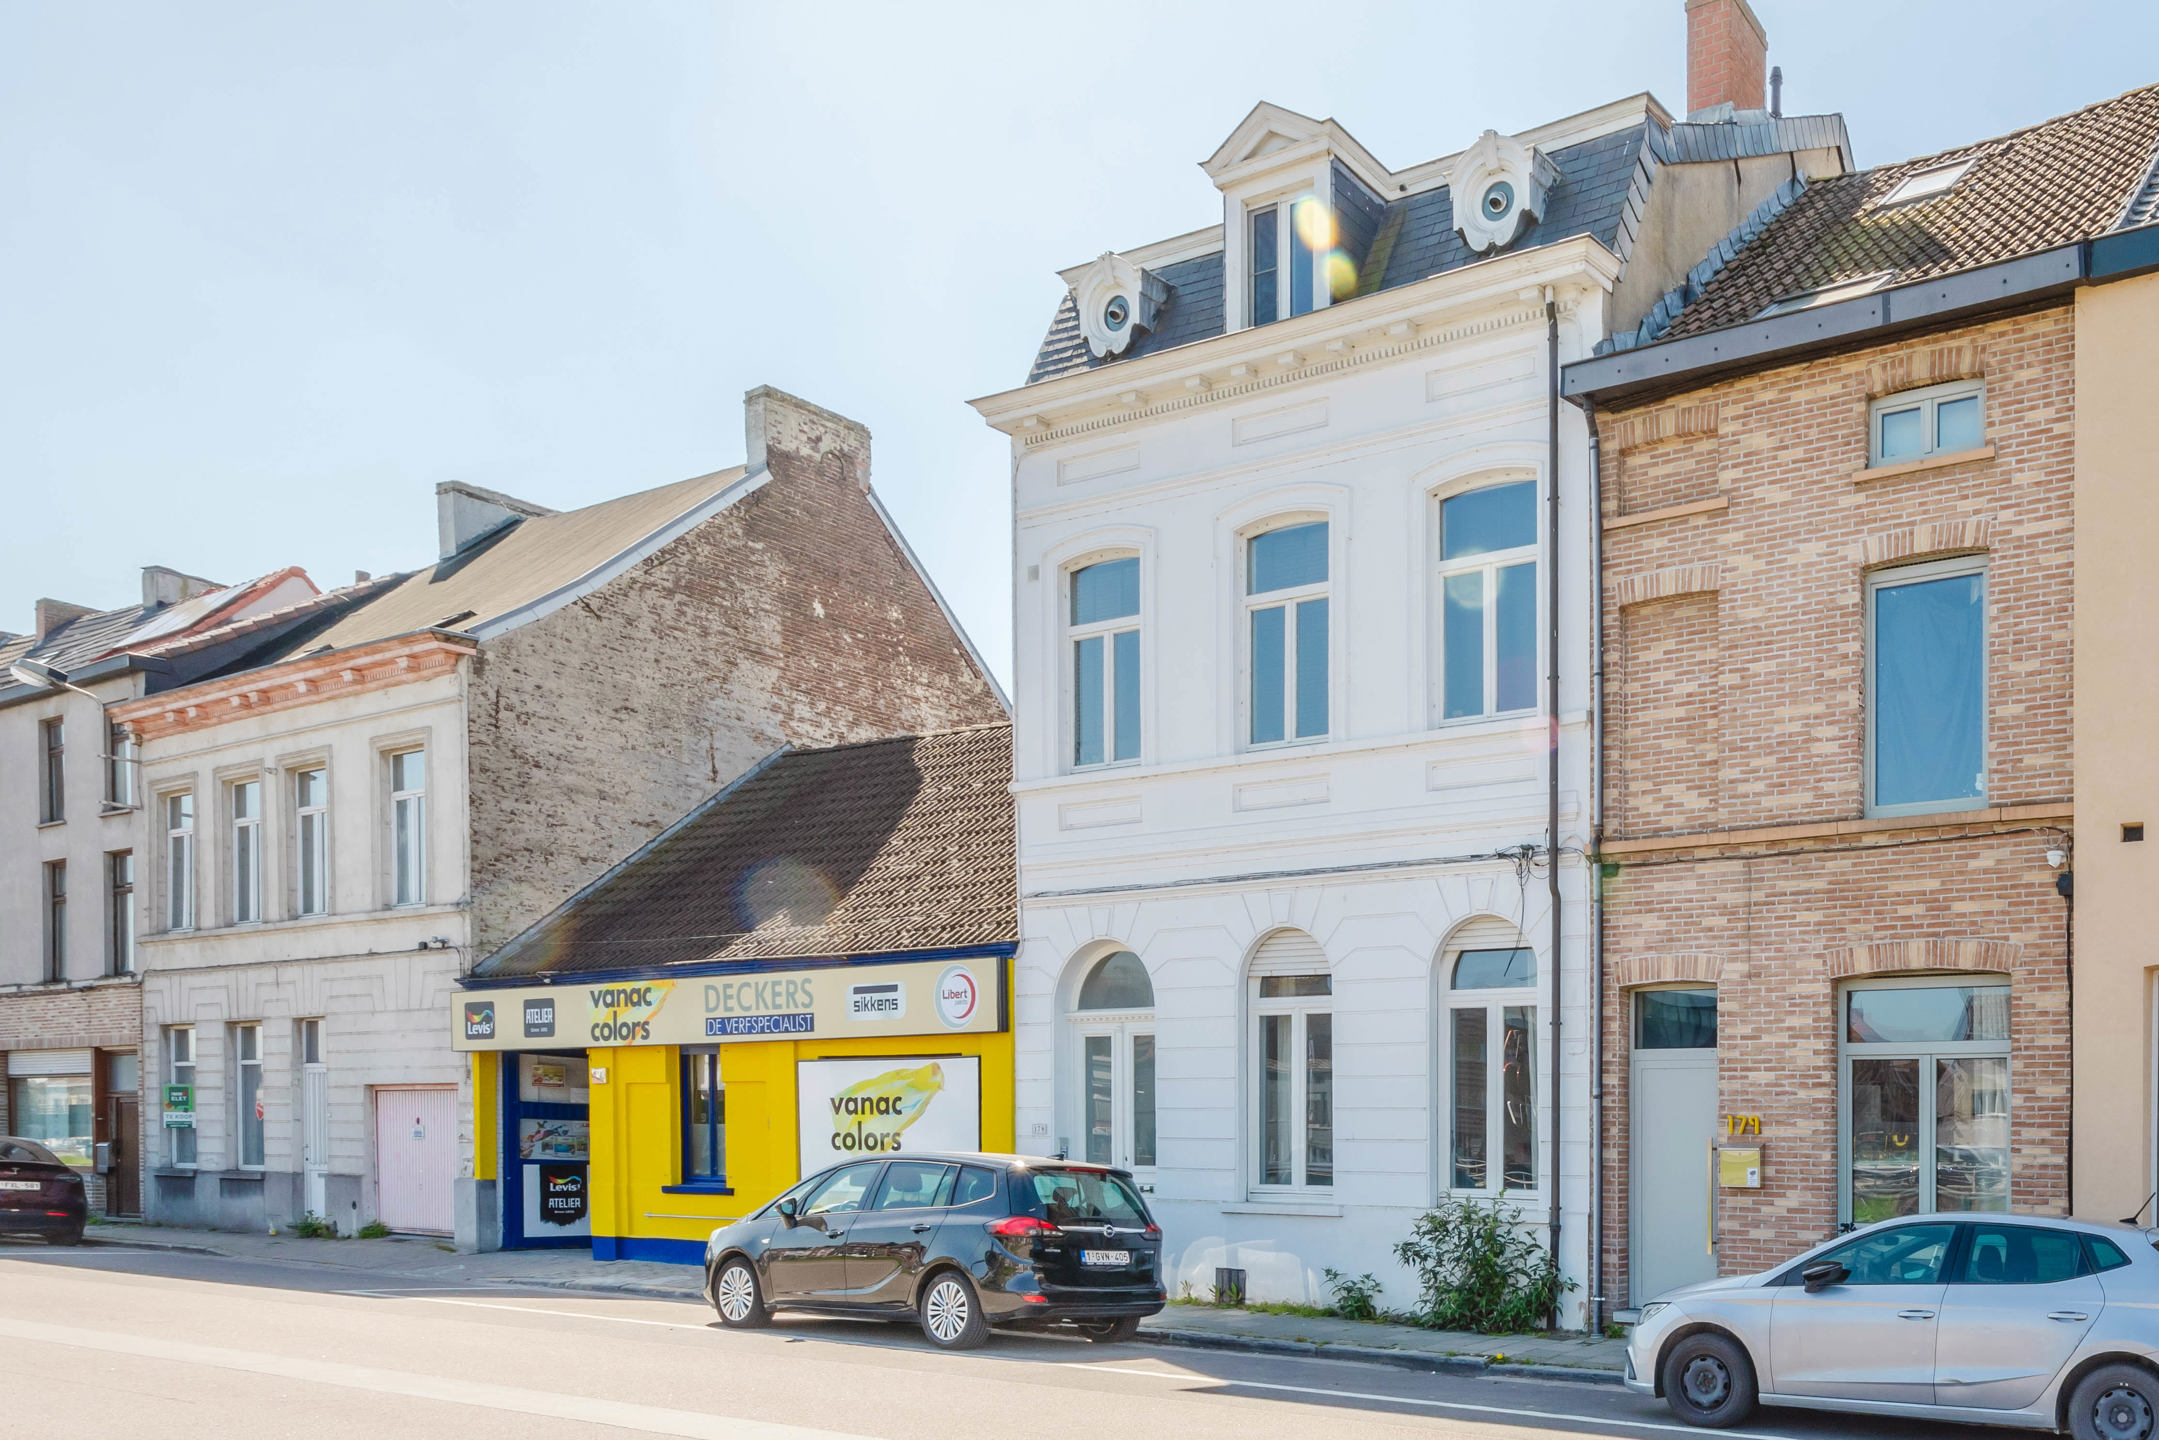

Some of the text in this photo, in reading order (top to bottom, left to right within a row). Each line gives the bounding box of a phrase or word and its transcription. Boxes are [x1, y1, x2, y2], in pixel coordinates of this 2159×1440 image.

[589, 987, 653, 1008] vanac
[704, 978, 814, 1013] DECKERS
[942, 988, 968, 1000] Libert
[853, 997, 899, 1013] sikkens
[525, 1008, 553, 1024] ATELIER
[591, 1010, 650, 1041] colors
[706, 1014, 813, 1035] DE VERFSPECIALIST
[830, 1096, 903, 1115] vanac
[1726, 1114, 1761, 1135] 179
[831, 1120, 902, 1151] colors
[548, 1197, 581, 1209] ATELIER
